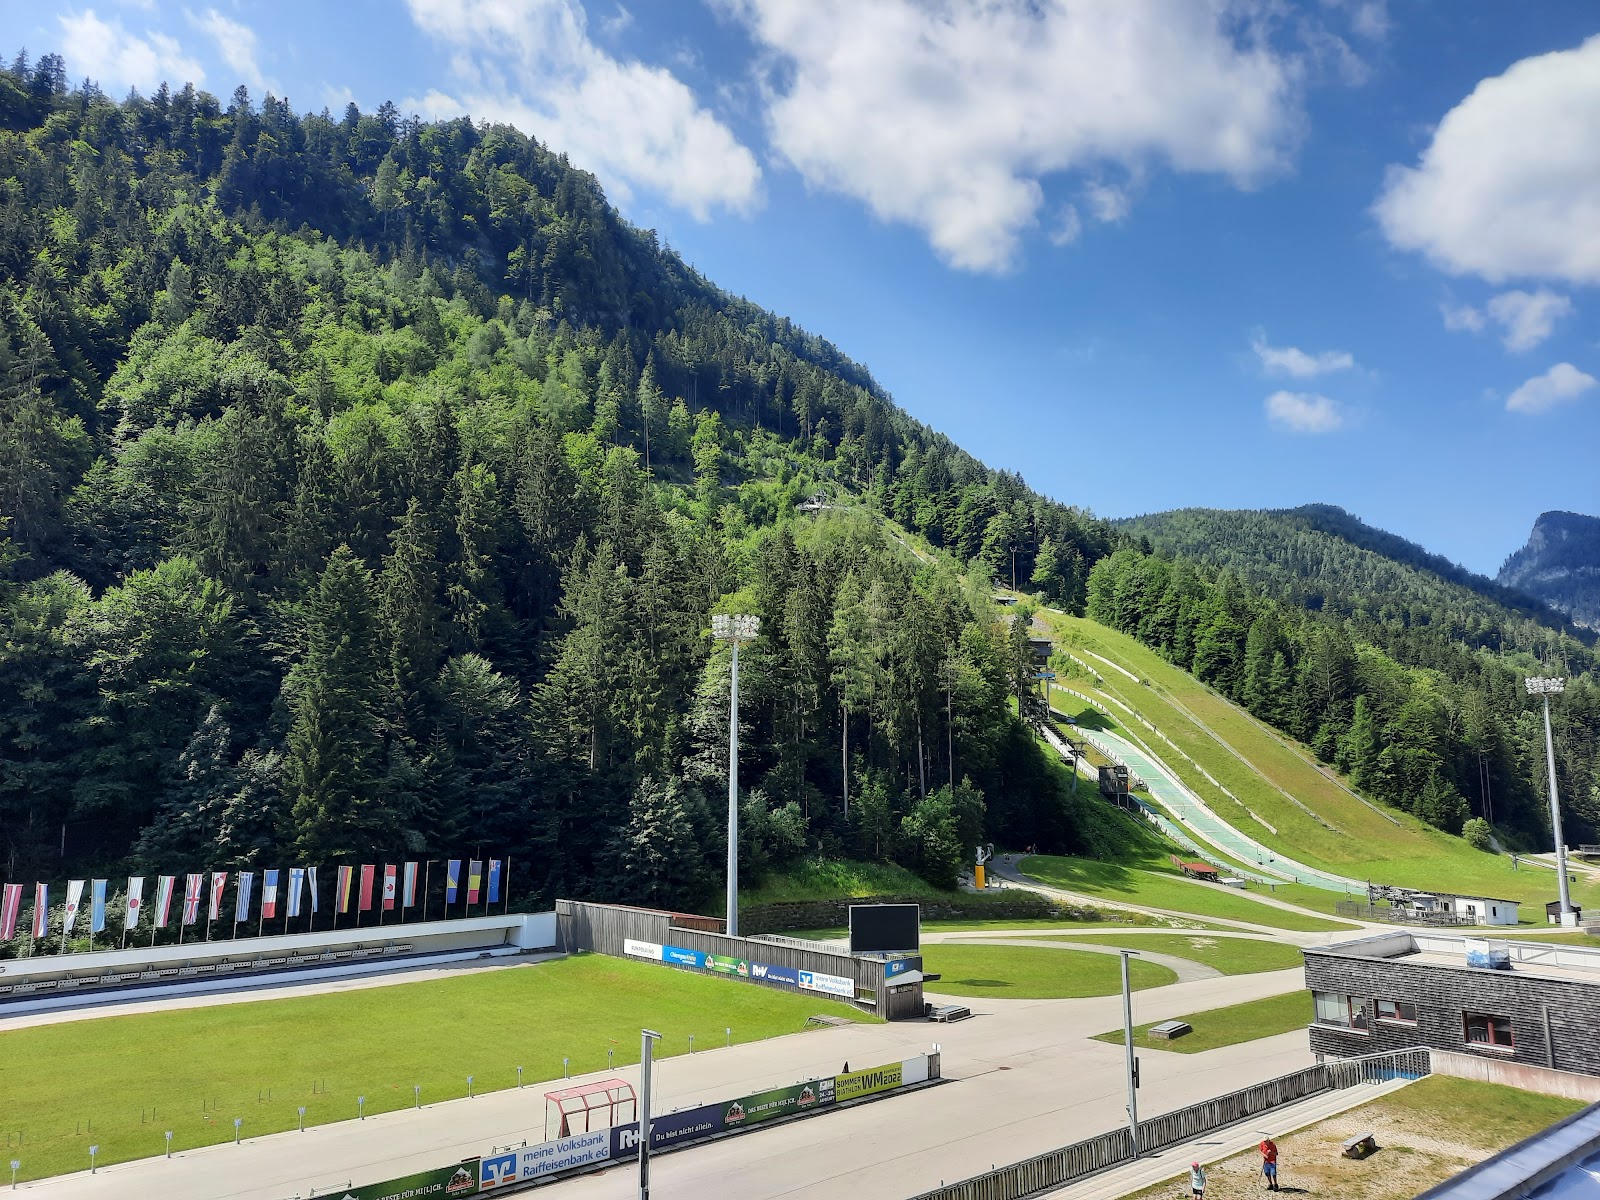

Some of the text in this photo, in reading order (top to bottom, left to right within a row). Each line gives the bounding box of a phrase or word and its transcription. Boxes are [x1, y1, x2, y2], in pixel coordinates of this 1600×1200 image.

[828, 976, 851, 986] Volksbank
[836, 1076, 861, 1089] SOMMER
[862, 1071, 883, 1090] WM
[883, 1072, 901, 1085] 2022
[836, 1085, 862, 1096] BIATHLON
[655, 1122, 714, 1142] Du bist nicht allein.
[523, 1133, 604, 1162] meine Volksbank
[523, 1147, 609, 1177] Raiffeisenbank eG
[401, 1189, 415, 1198] FÜR
